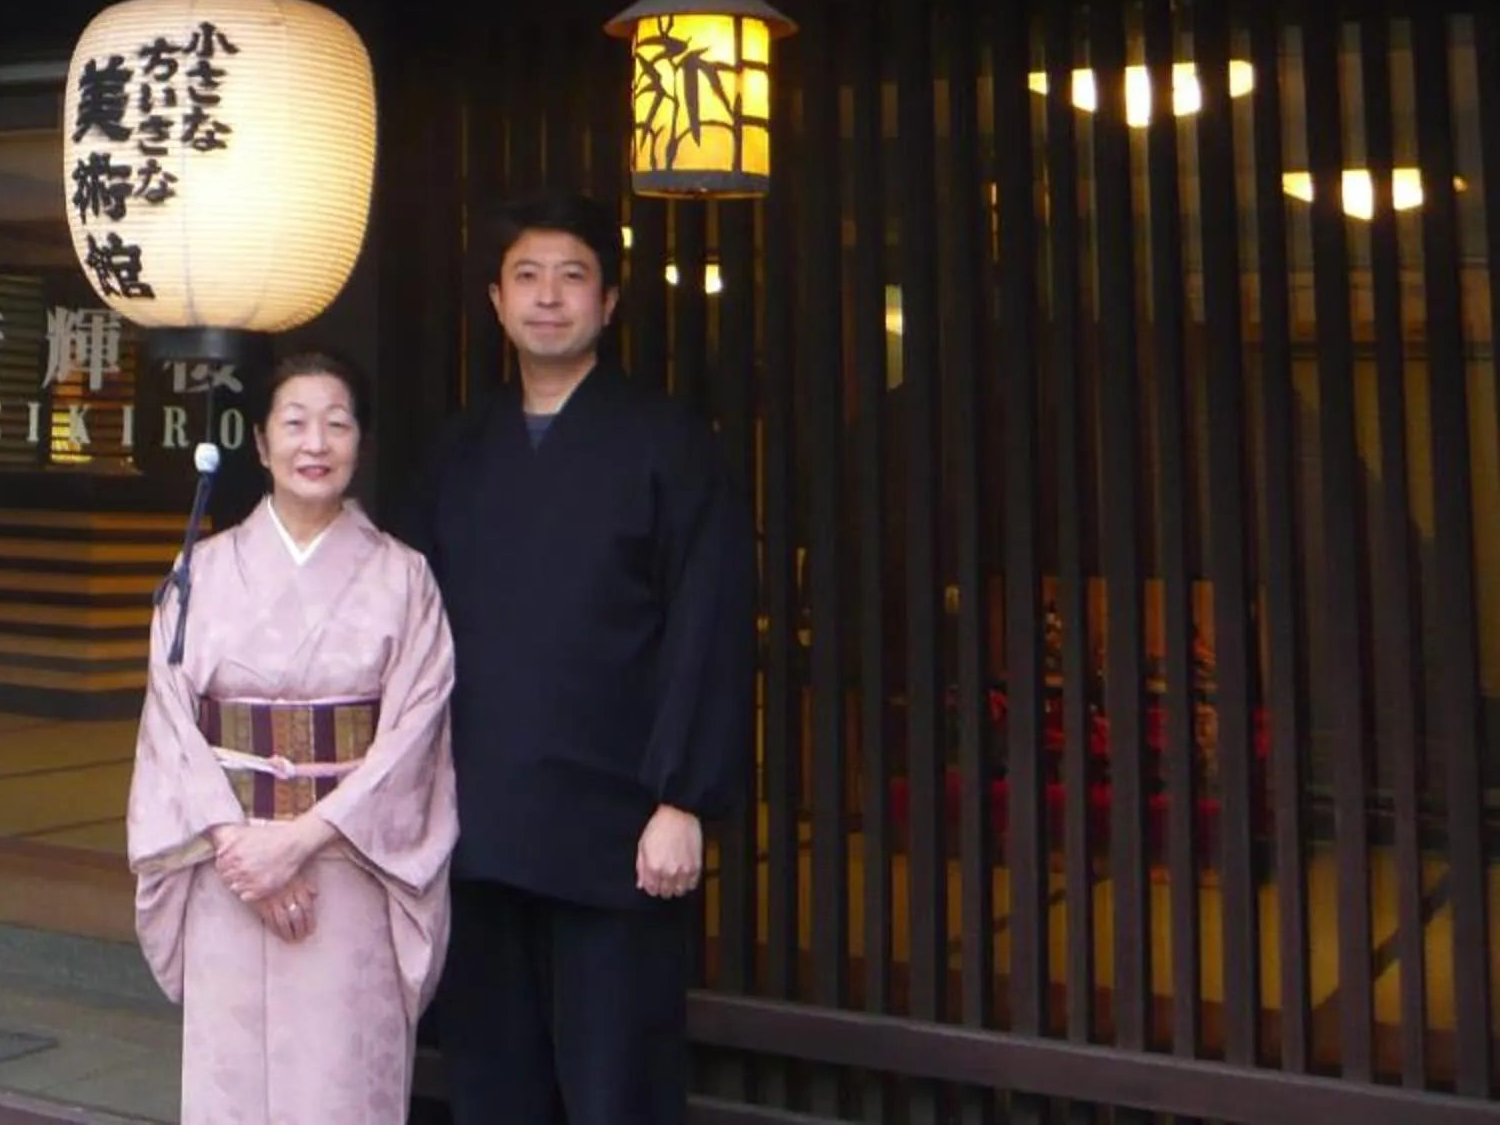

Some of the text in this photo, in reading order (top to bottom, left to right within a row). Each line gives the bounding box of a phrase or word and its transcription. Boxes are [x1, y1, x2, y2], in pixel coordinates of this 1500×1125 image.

[71, 53, 156, 301] 美術館
[179, 20, 241, 153] 小さな
